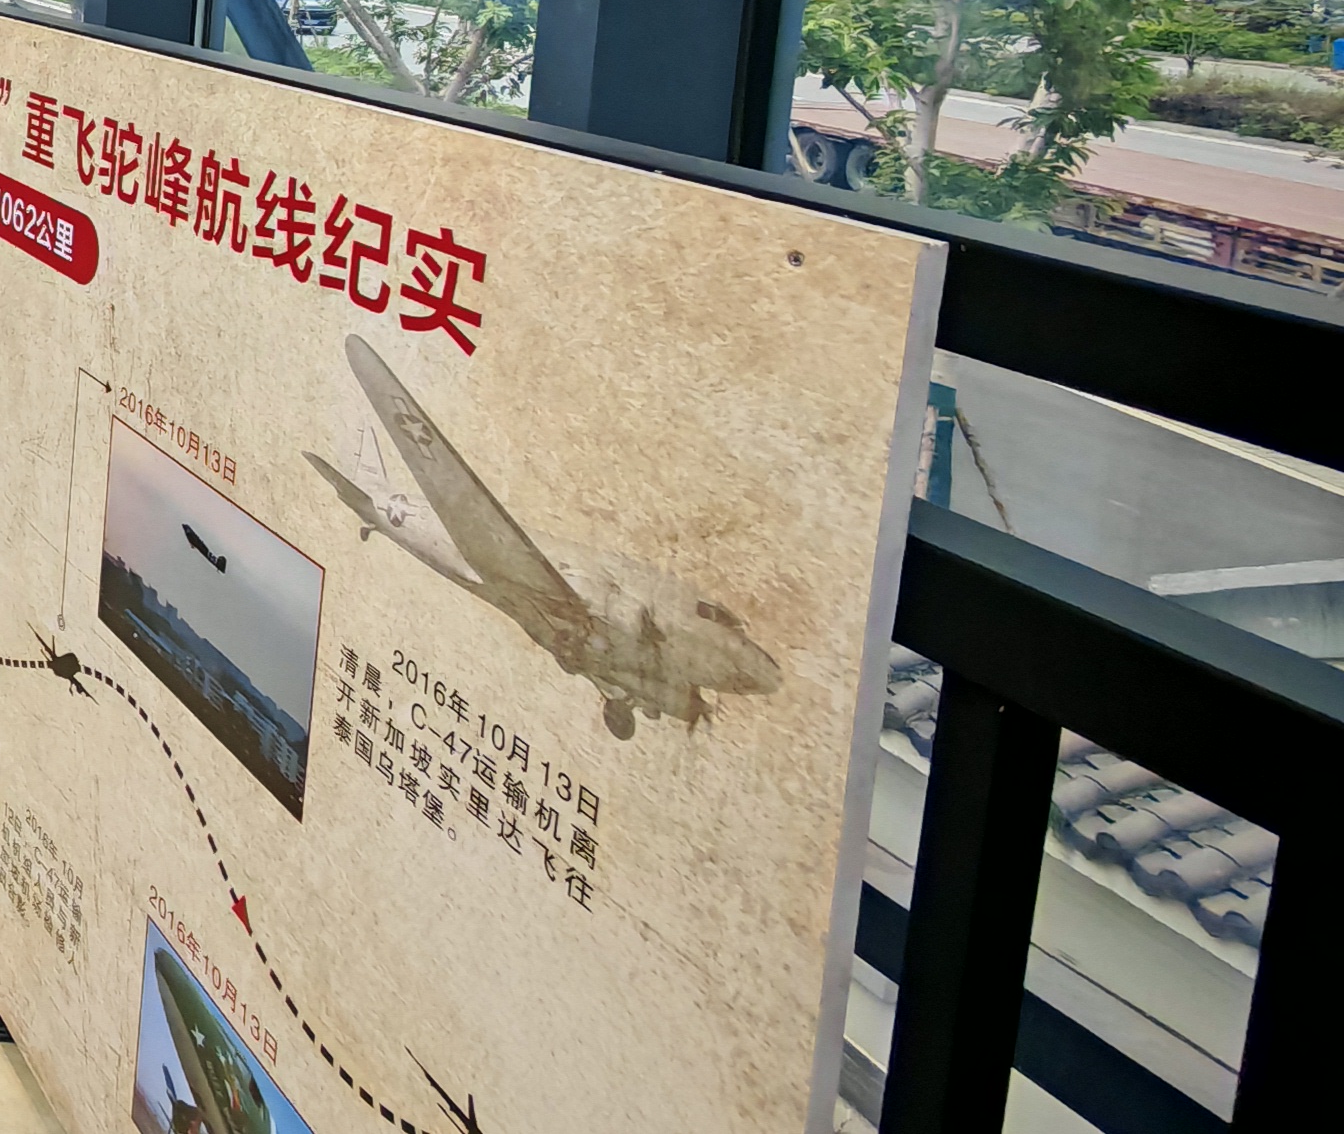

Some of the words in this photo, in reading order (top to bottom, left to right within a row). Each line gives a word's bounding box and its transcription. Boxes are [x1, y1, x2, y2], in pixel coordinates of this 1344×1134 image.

[119, 386, 238, 486] 2016年10月13日
[335, 677, 594, 915] 开新加坡实里达飞往
[392, 649, 470, 724] 2016年
[477, 713, 531, 773] 10月
[540, 761, 600, 827] 13日
[147, 884, 279, 1067] 2016年10月13日
